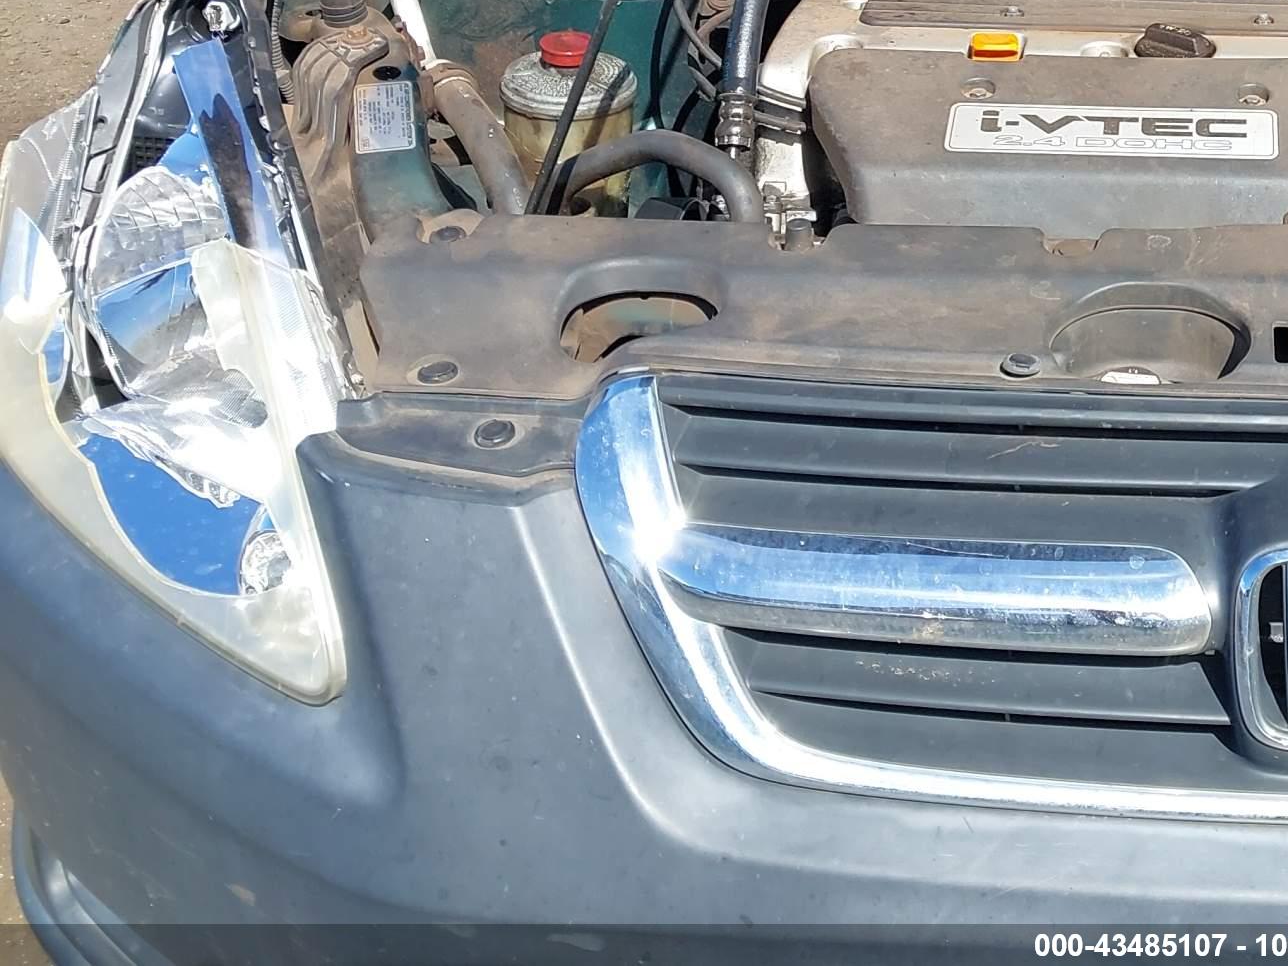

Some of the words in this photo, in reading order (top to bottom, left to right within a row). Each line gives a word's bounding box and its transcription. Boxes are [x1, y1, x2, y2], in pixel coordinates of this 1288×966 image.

[980, 109, 1248, 138] i-VTEC
[992, 134, 1066, 147] 2.4
[1075, 136, 1232, 151] DOHC
